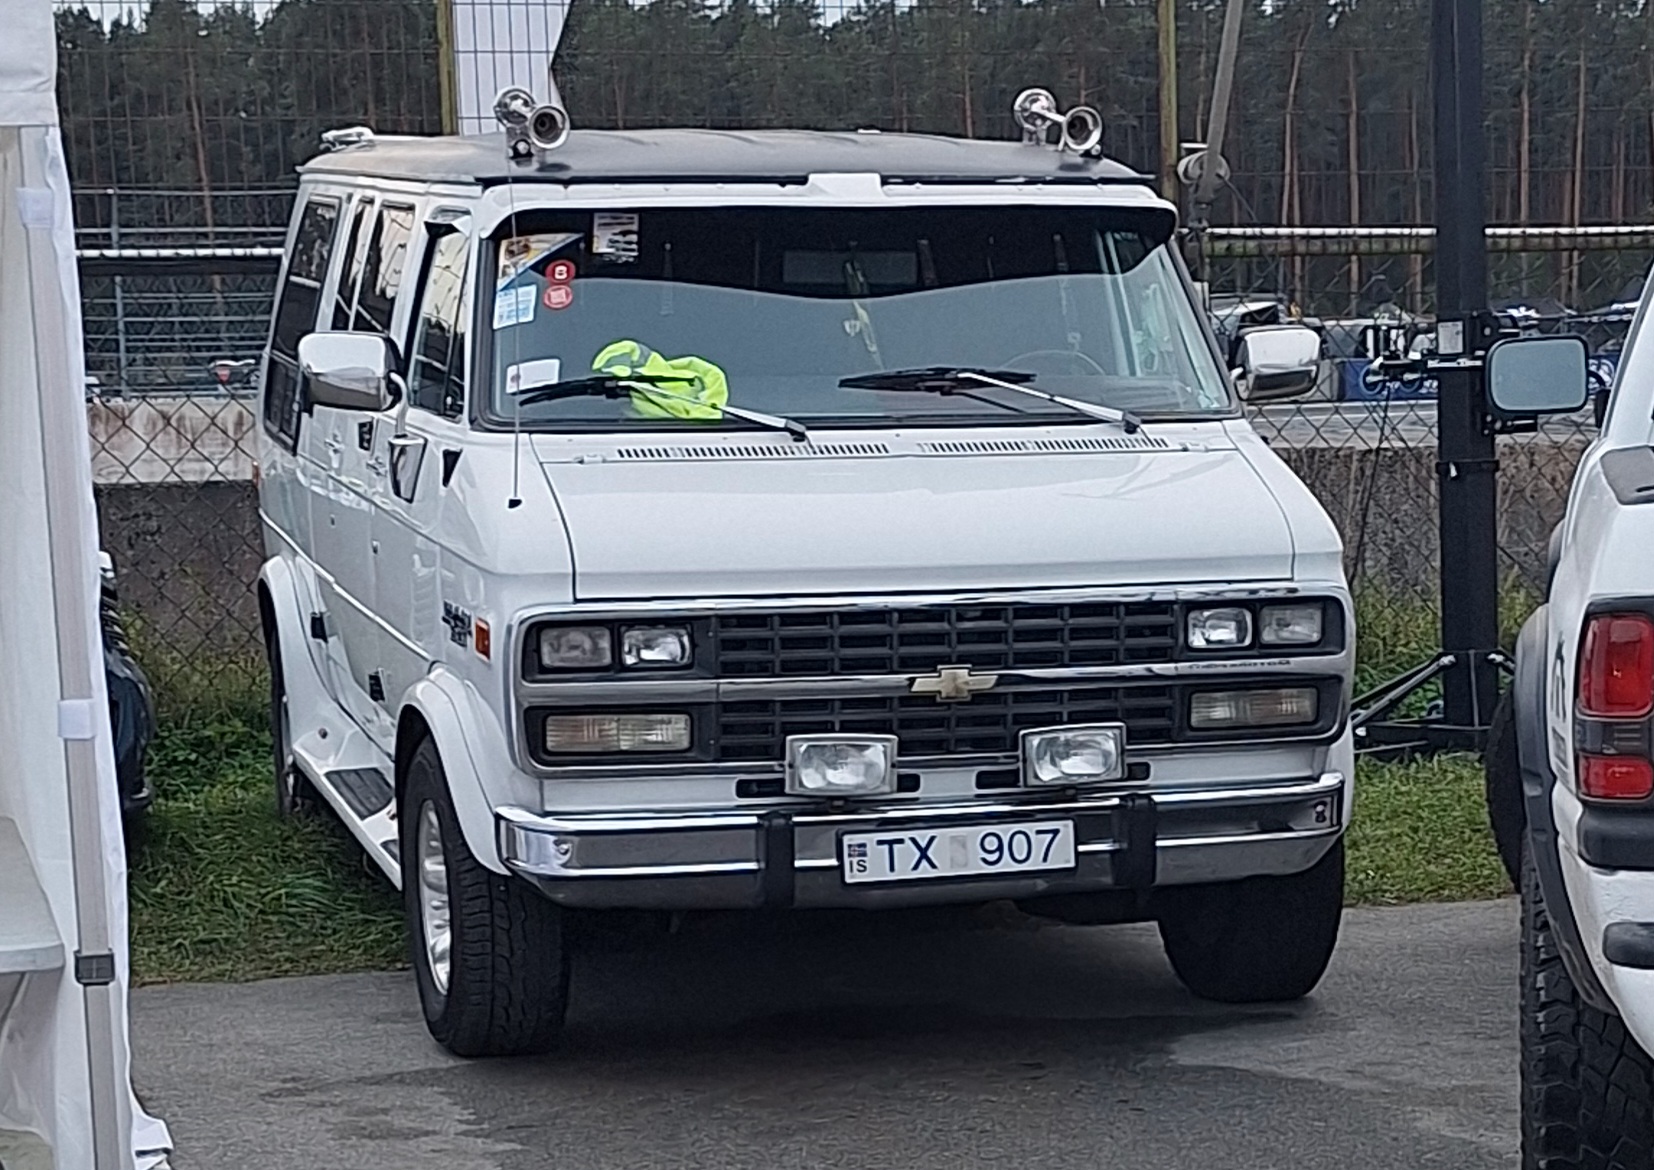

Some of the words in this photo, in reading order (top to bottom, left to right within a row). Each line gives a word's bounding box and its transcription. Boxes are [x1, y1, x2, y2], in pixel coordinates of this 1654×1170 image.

[876, 835, 938, 873] TX
[979, 828, 1061, 867] 907
[849, 860, 868, 874] IS
